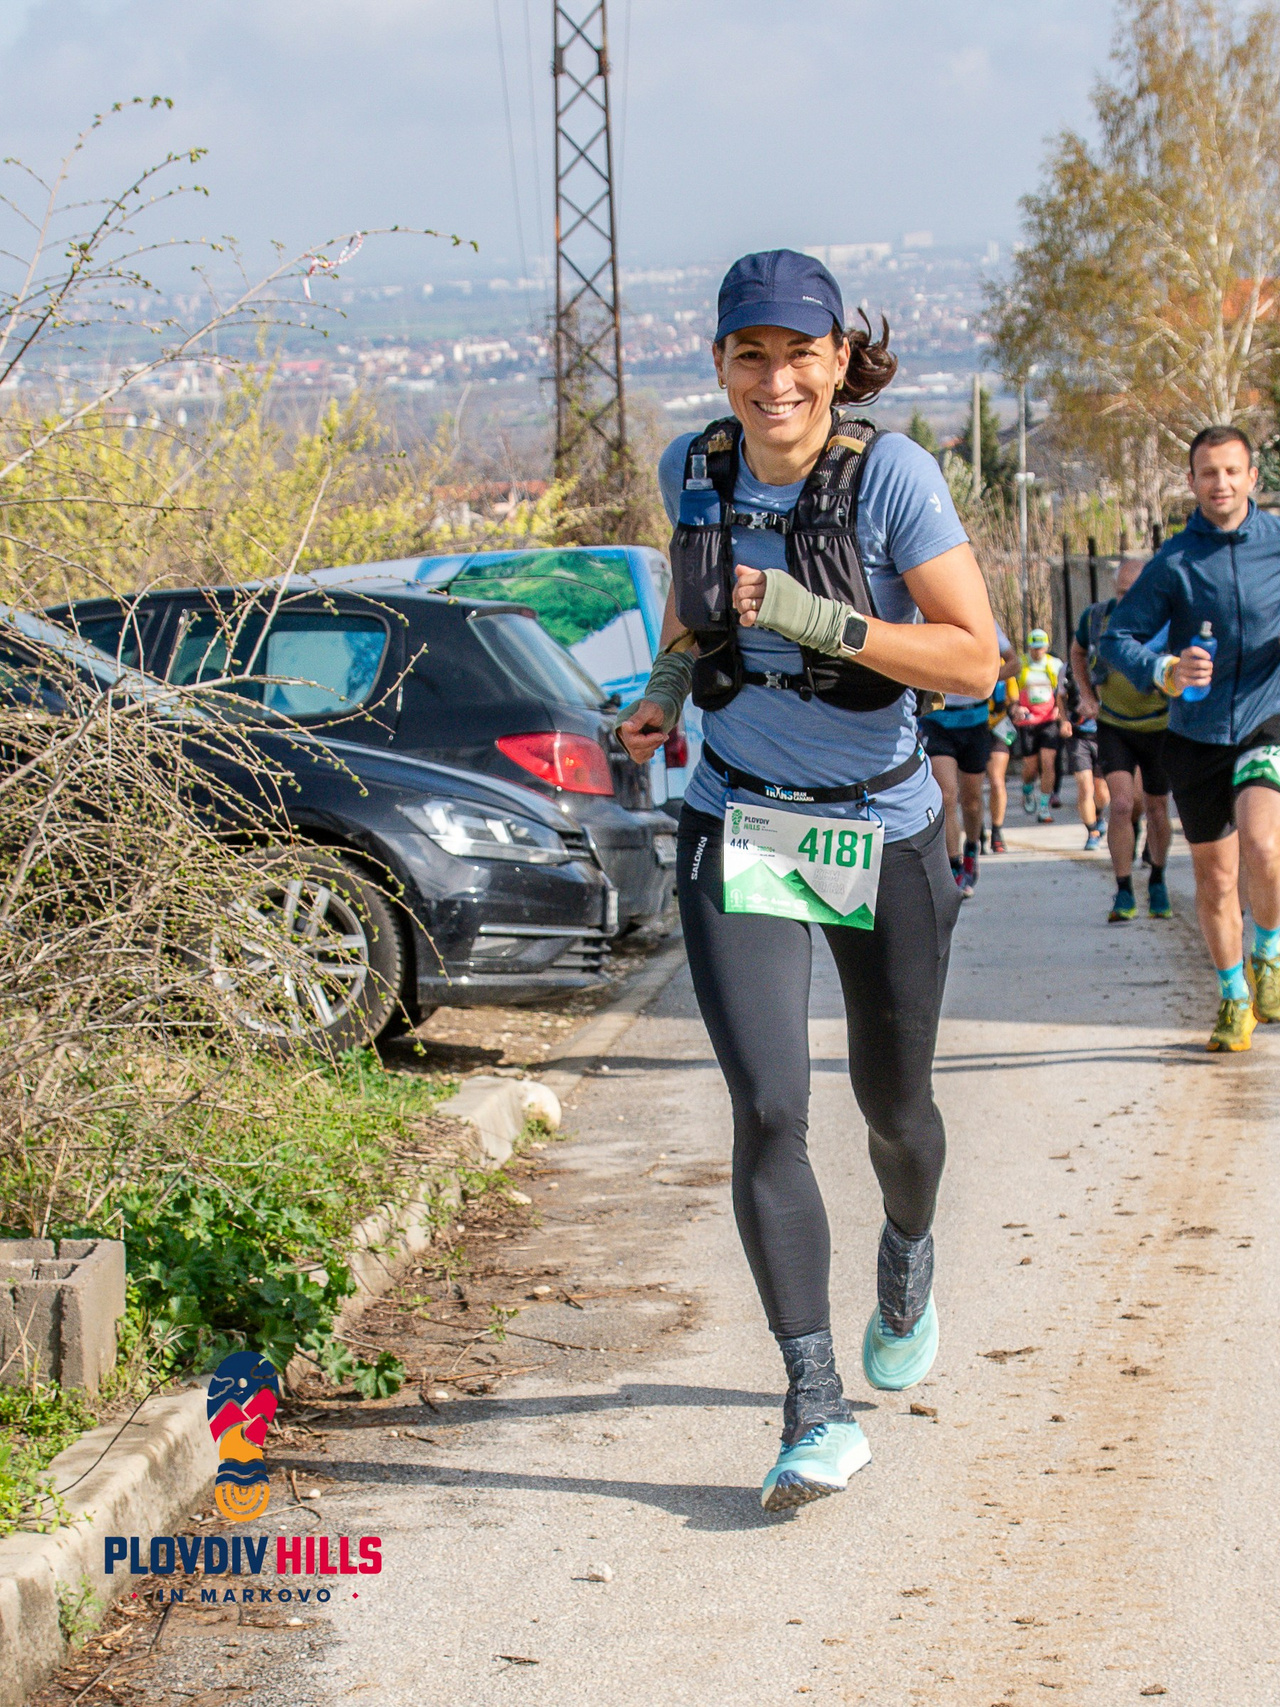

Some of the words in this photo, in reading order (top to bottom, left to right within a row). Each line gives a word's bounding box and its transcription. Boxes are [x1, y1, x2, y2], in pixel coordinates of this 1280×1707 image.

[764, 785, 793, 801] TRANS
[744, 816, 770, 825] PLOVDIV
[743, 823, 761, 831] HILLS
[730, 838, 749, 850] 44K
[798, 826, 874, 870] 4181
